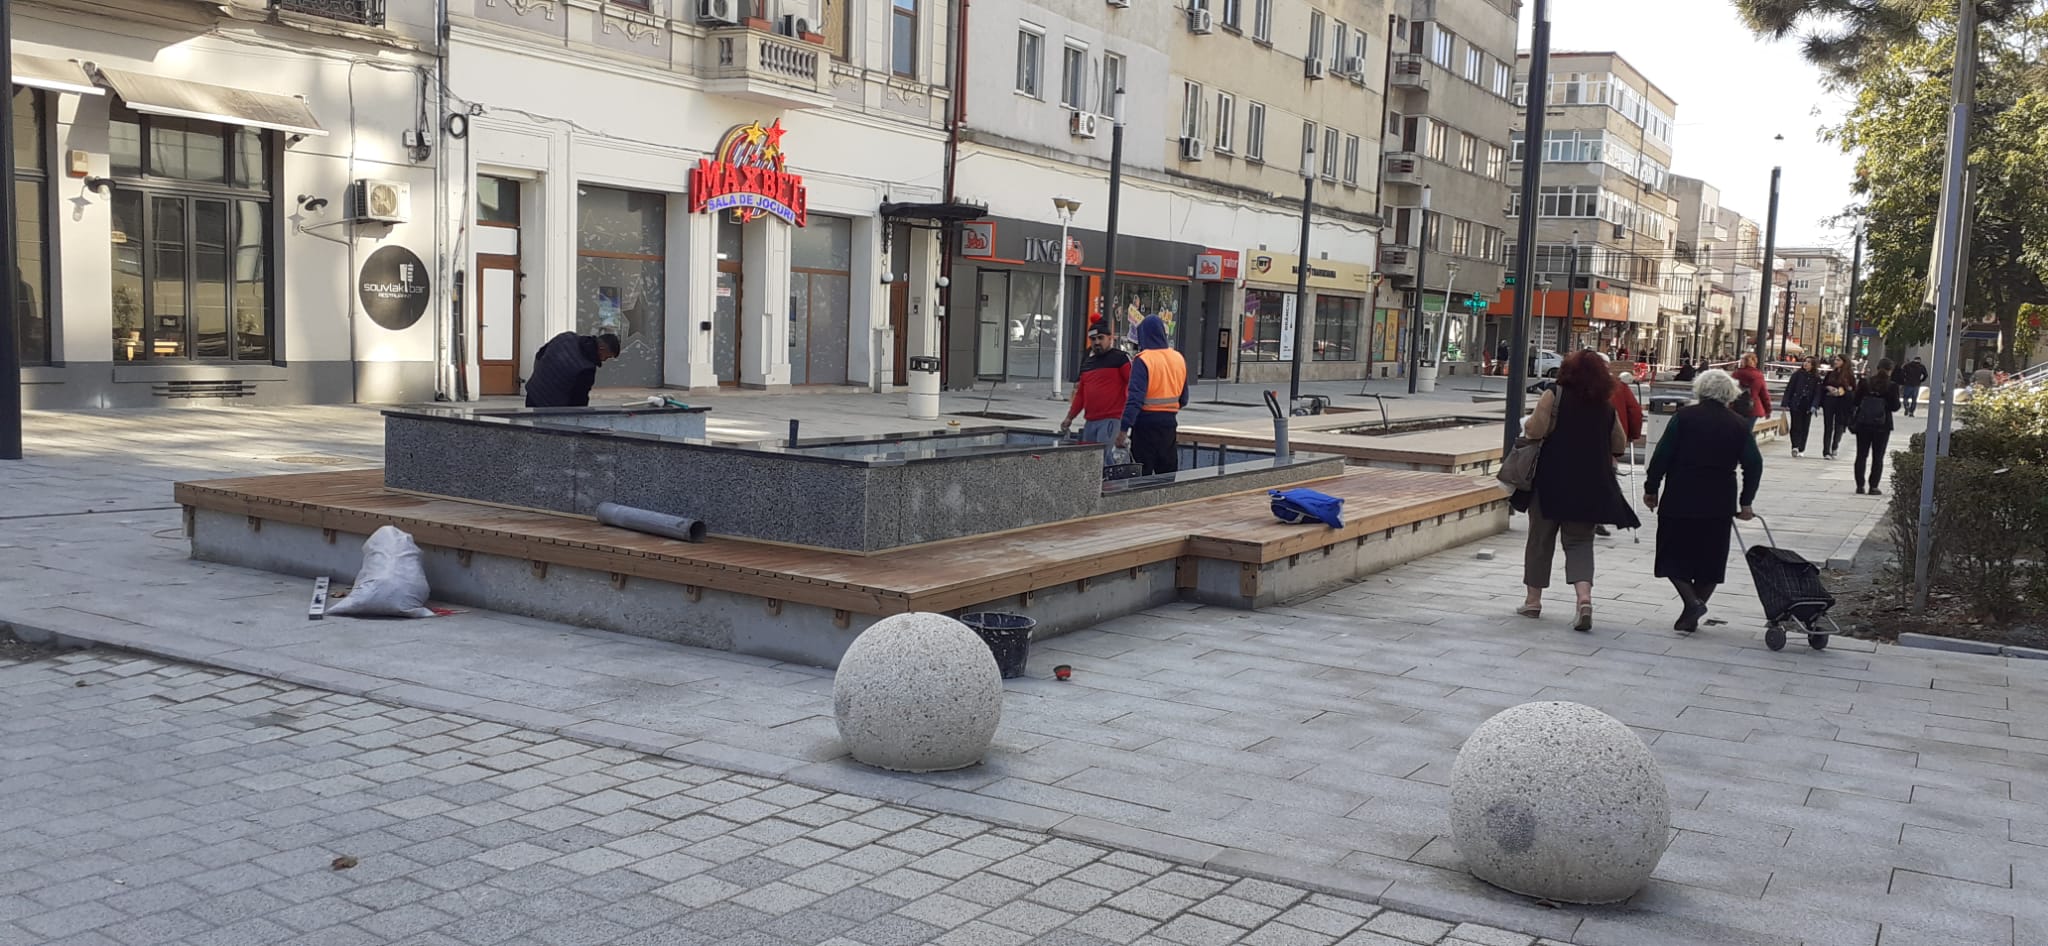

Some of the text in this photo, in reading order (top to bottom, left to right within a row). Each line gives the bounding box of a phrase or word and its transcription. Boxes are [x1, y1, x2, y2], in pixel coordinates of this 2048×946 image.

[699, 158, 802, 214] MAXBET
[708, 194, 794, 221] SALA DE JOCURI
[1025, 236, 1063, 264] ING
[409, 283, 425, 293] bar
